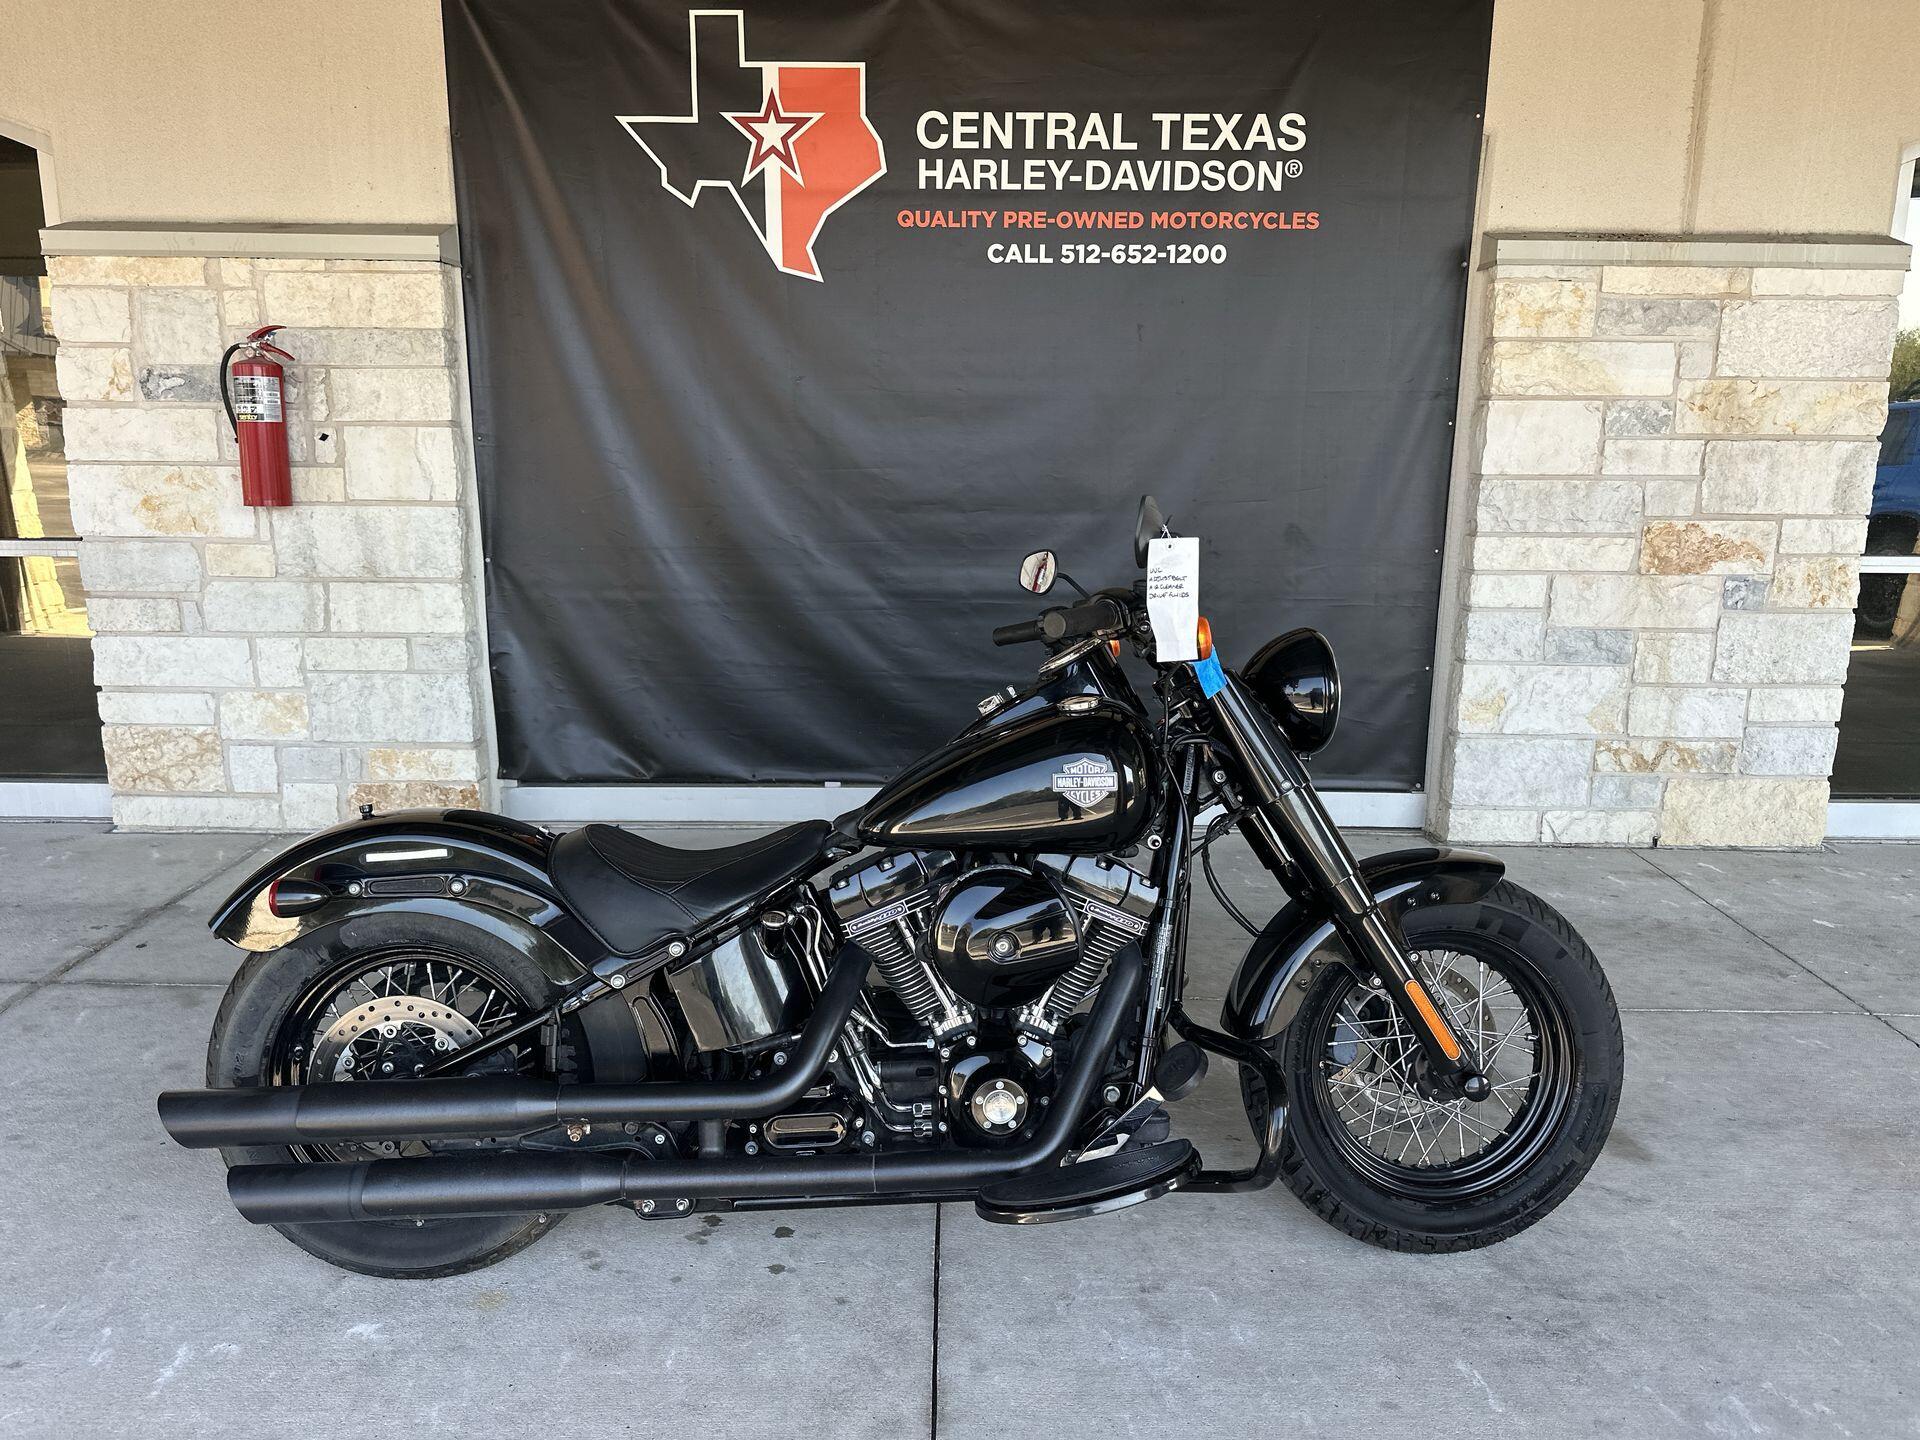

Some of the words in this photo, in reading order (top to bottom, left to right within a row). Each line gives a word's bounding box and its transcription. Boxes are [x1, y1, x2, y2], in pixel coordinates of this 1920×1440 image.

[917, 111, 1137, 150] CENTRAL
[1152, 113, 1306, 151] TEXAS
[897, 210, 997, 229] QUALITY
[1004, 211, 1144, 229] PRE-OWNED
[1151, 212, 1319, 229] MOTORCYCLES
[987, 244, 1053, 263] CALL
[1060, 244, 1227, 264] 512-652-1200
[1070, 763, 1101, 774] MOTOR
[1057, 777, 1114, 788] HARLEY-DAVIDSON
[1070, 790, 1101, 803] CYCLES
